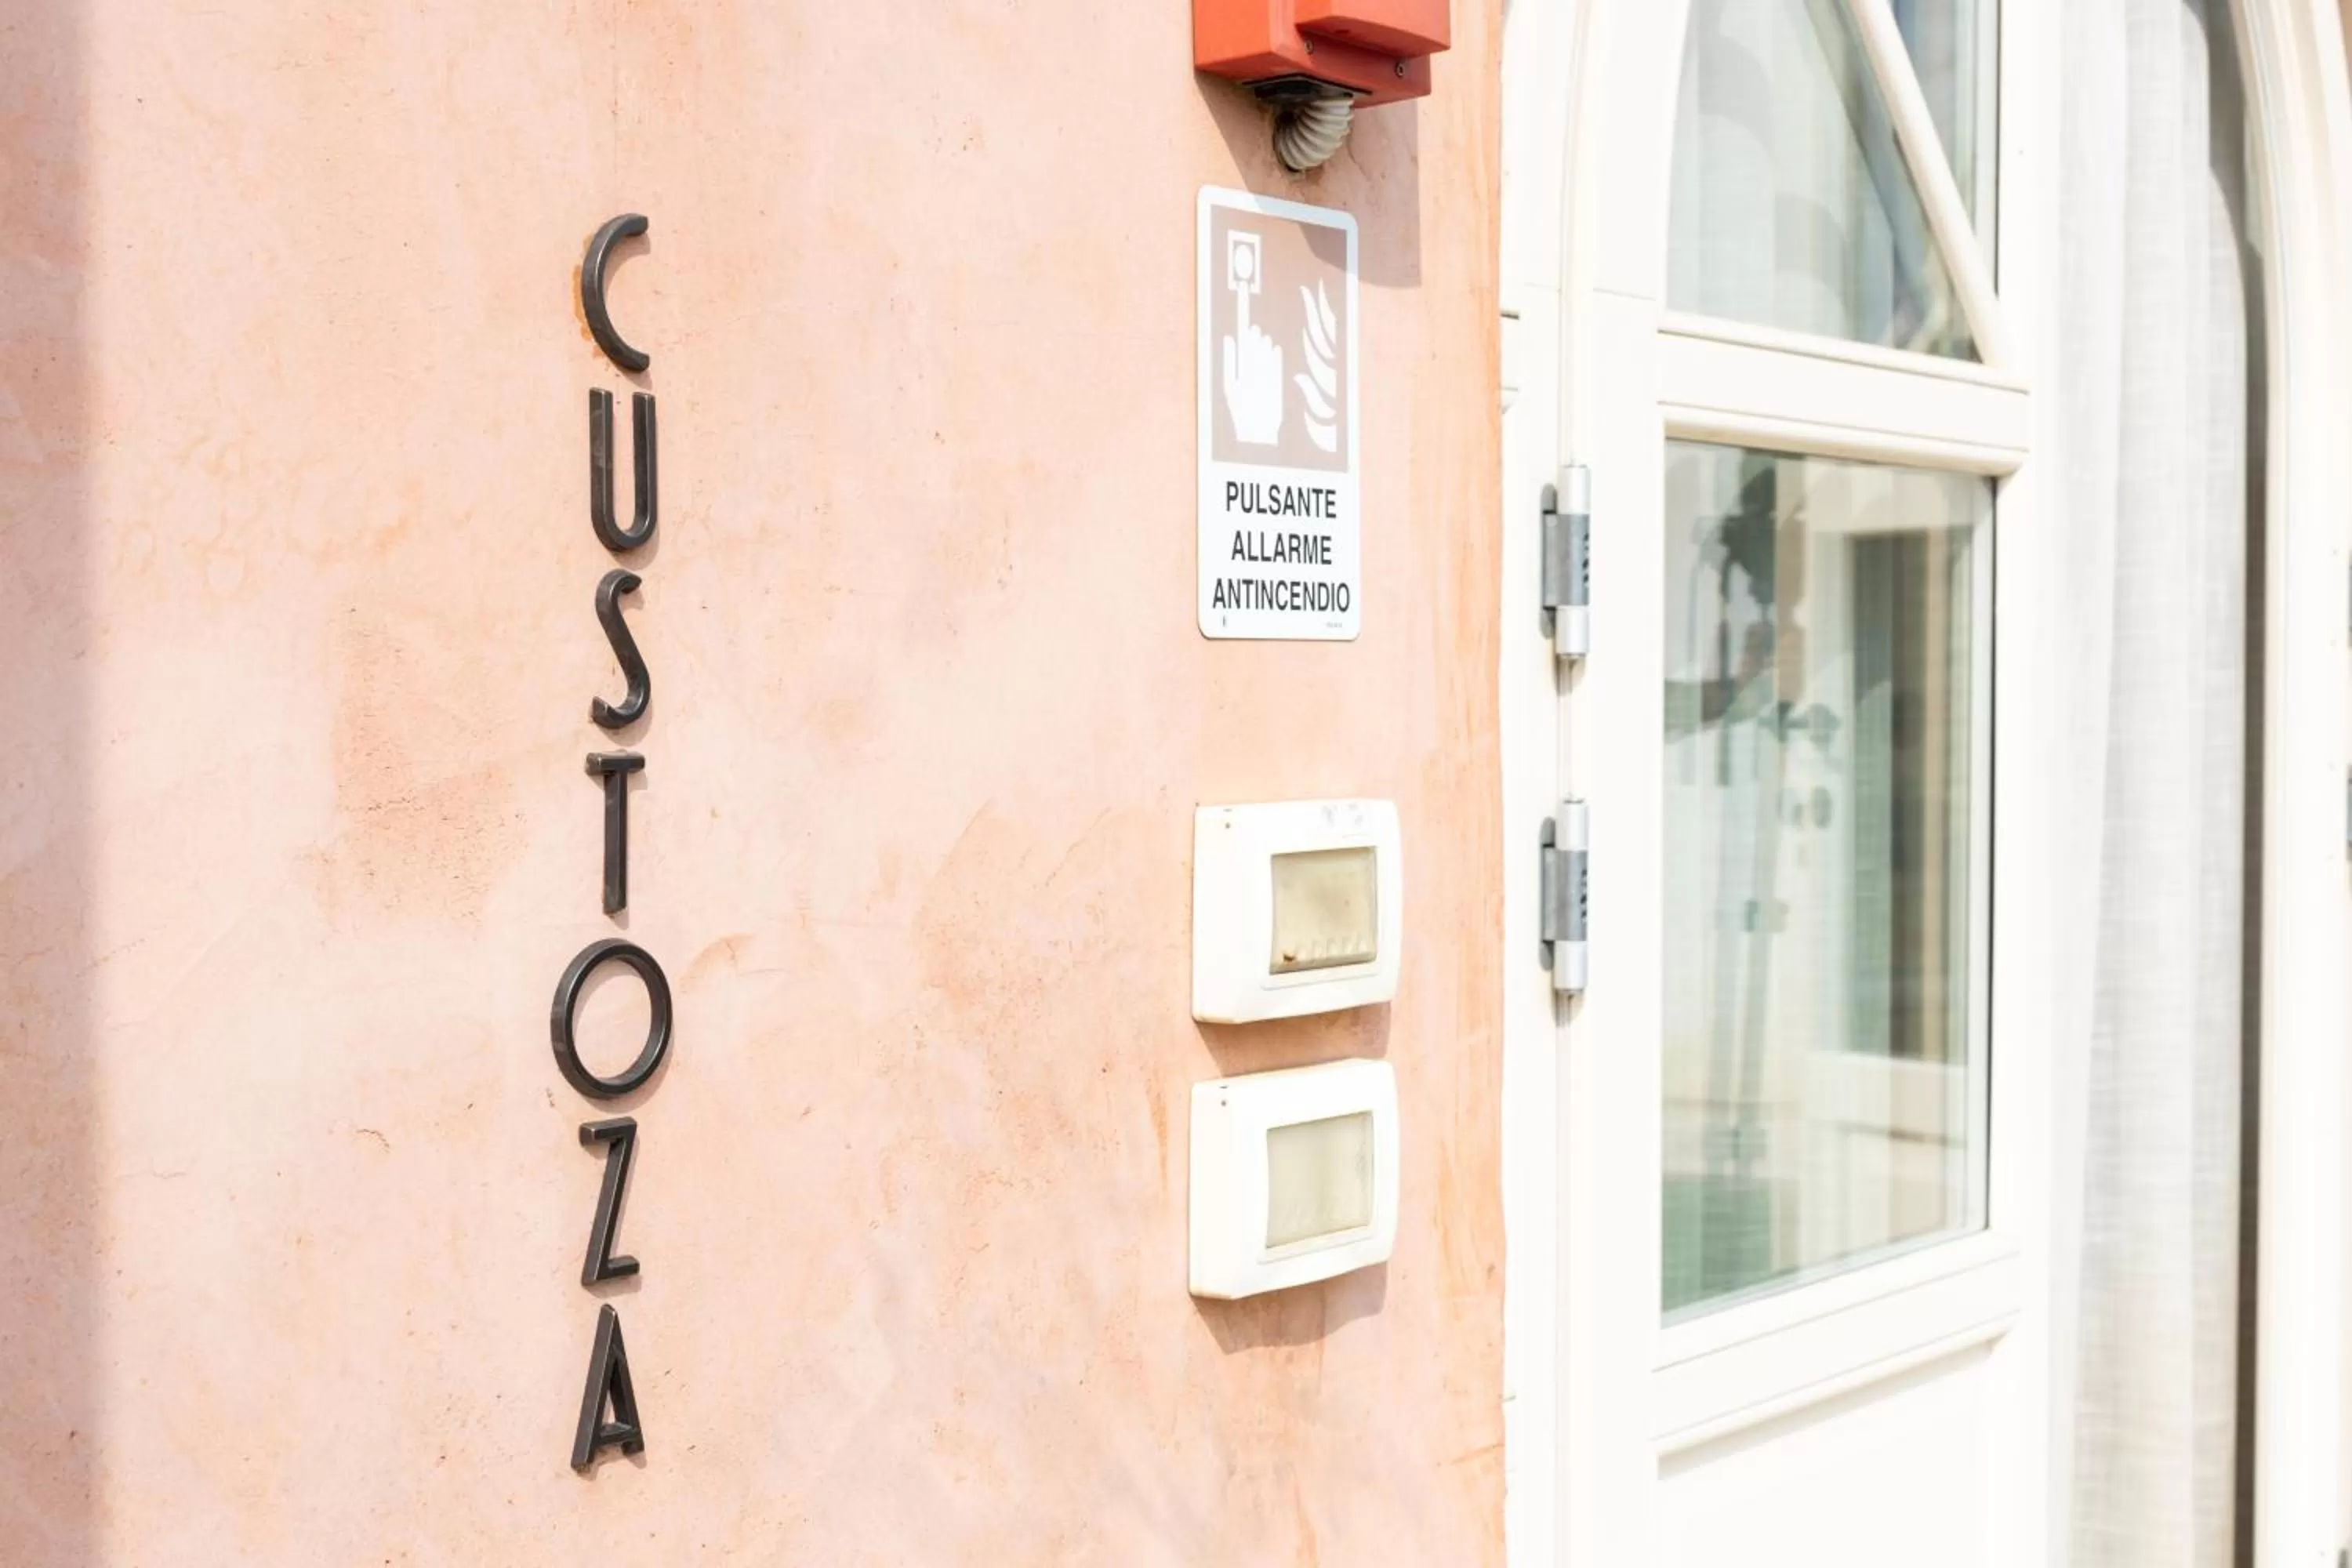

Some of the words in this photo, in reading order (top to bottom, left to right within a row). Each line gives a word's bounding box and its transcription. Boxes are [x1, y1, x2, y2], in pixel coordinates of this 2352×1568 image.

[1225, 481, 1337, 519] PULSANTE
[1231, 530, 1332, 565] ALLARME
[1212, 578, 1350, 612] ANTINCENDIO
[550, 212, 673, 1472] CUSTOZA
